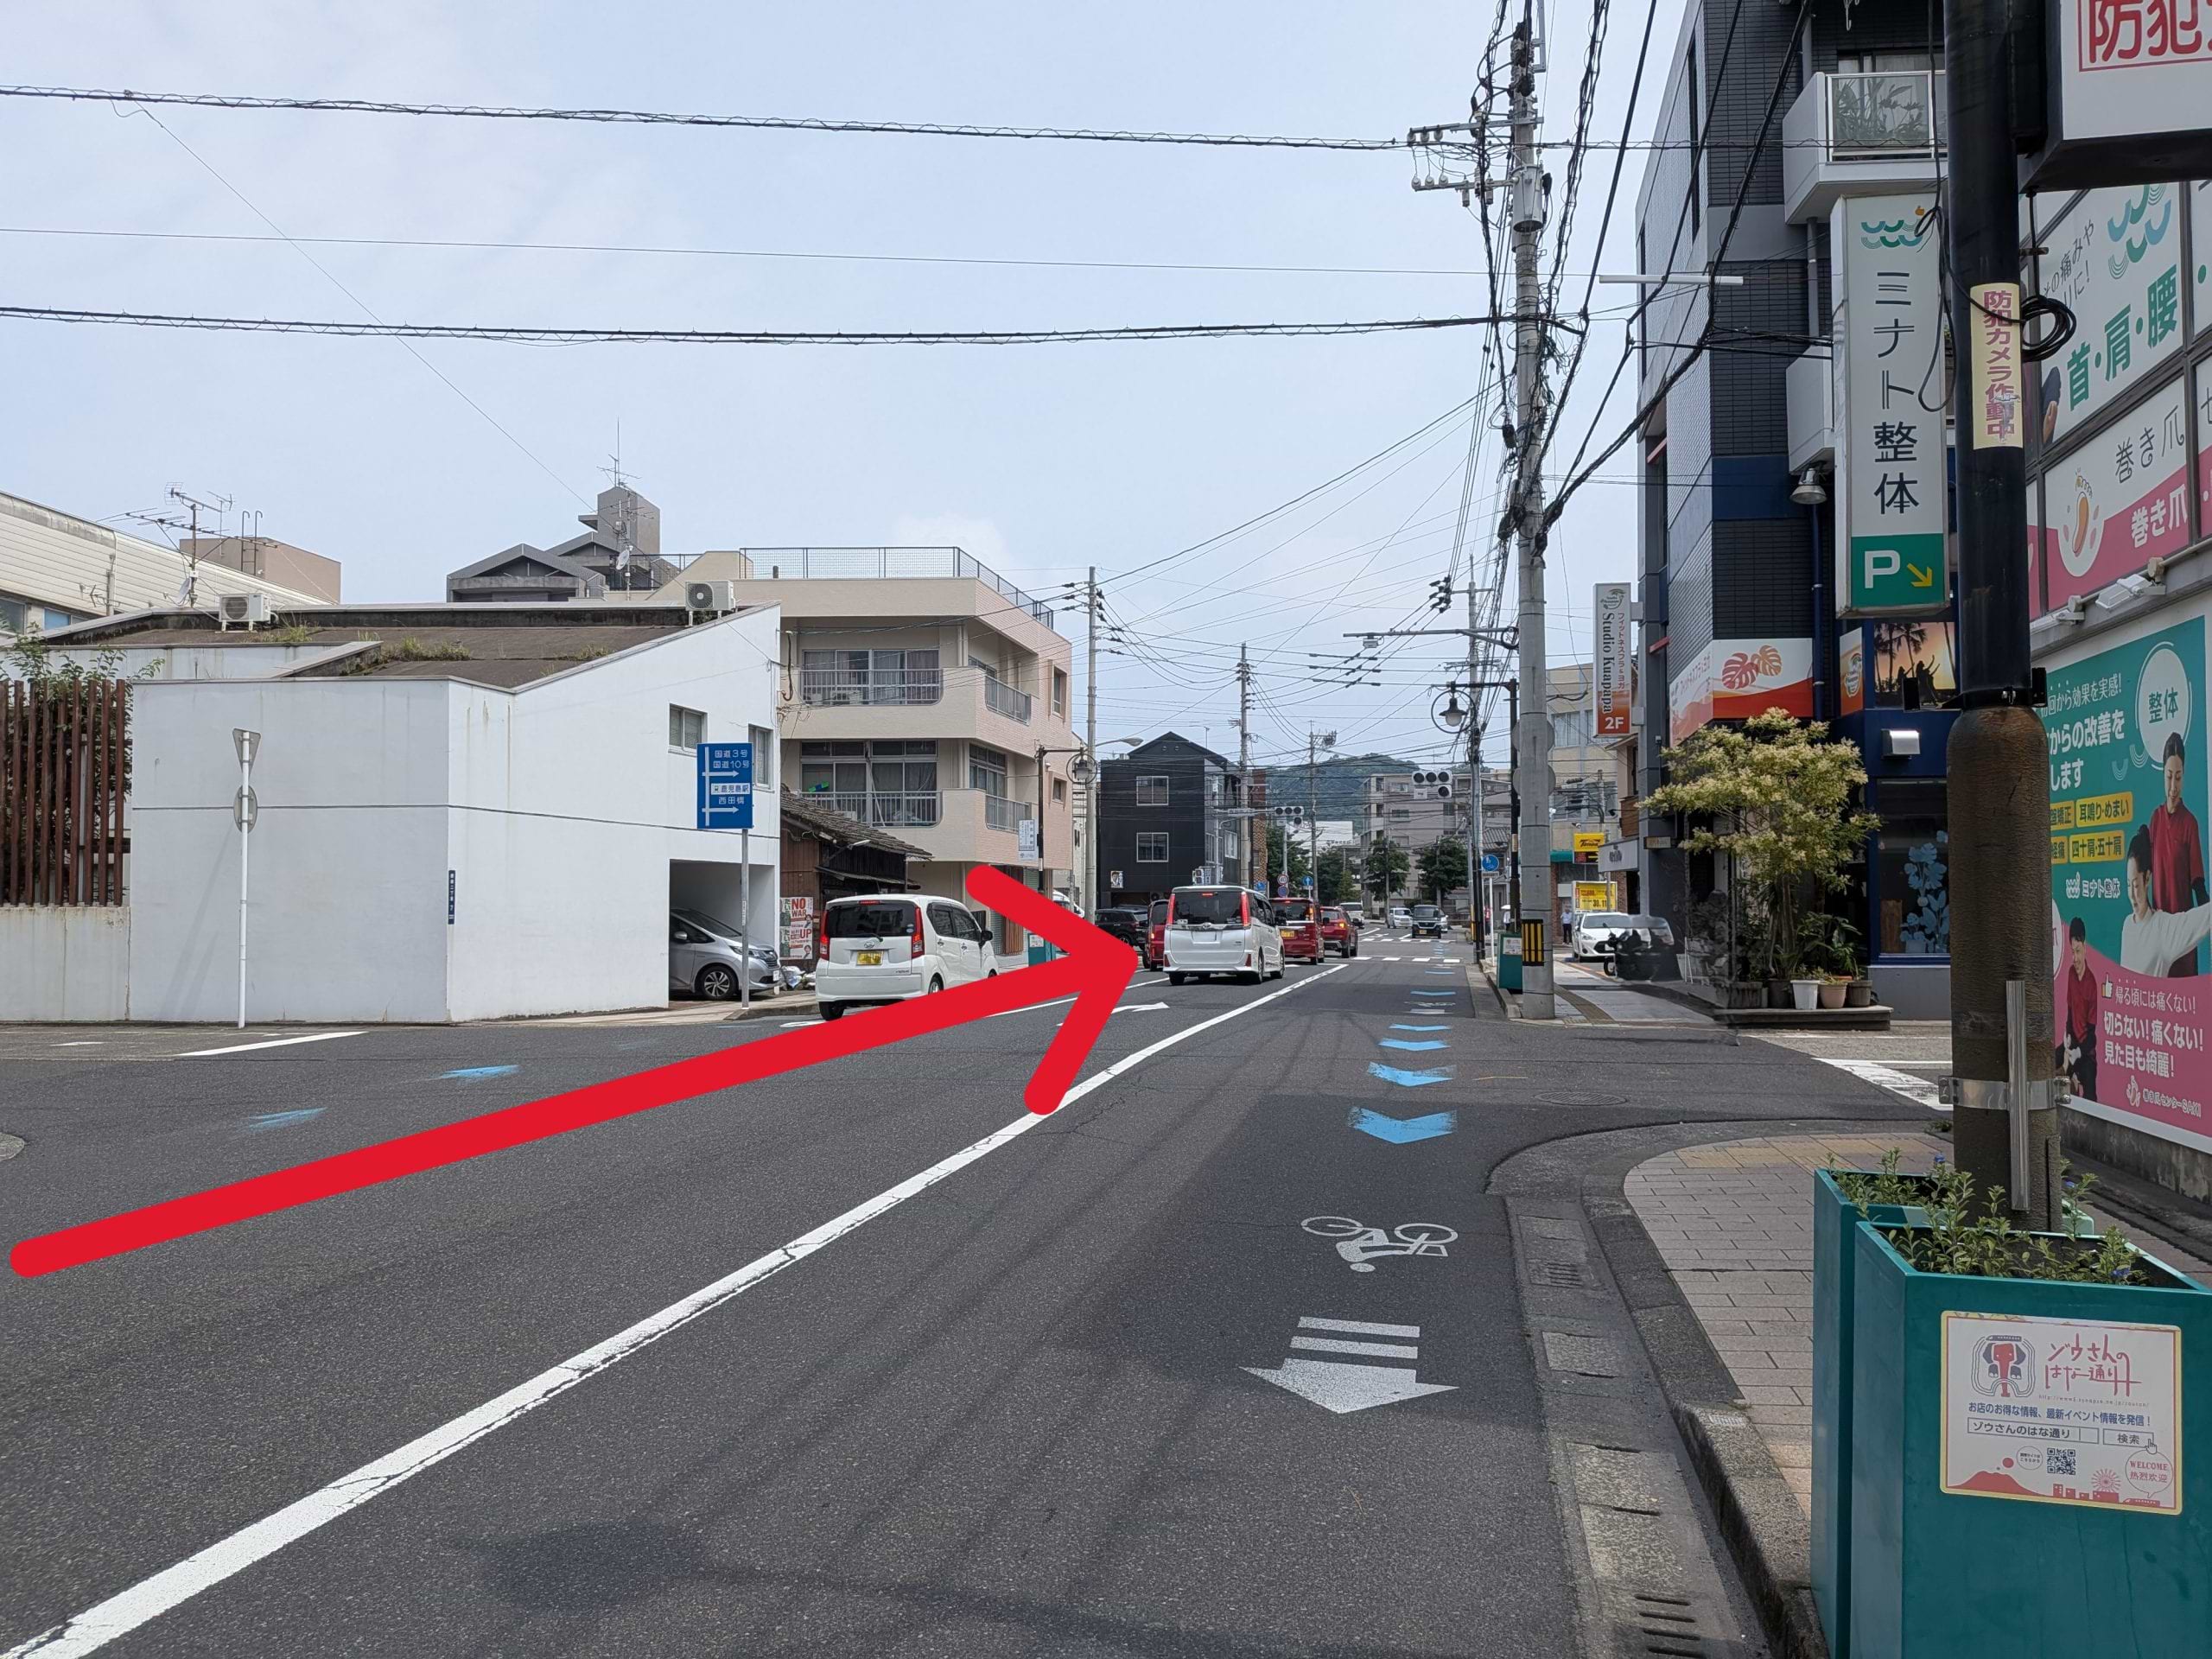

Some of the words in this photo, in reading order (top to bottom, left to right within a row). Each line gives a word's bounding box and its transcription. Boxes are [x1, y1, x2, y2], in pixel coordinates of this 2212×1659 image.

[2089, 0, 2212, 63] 防犯
[1983, 290, 2015, 442] 防犯カメラ作動中
[1873, 272, 1919, 515] ミナト整体
[1865, 550, 1900, 588] P
[1603, 613, 1614, 653] Studio
[1601, 658, 1614, 712] Kuapapa
[2149, 688, 2178, 724] 整体
[1605, 717, 1624, 729] 2F
[713, 760, 749, 769] 国道10号
[715, 749, 747, 759] 国道3号
[2082, 878, 2120, 899] ミナト整体
[791, 898, 806, 910] NO
[791, 909, 807, 918] WAR
[800, 928, 812, 939] UP
[2115, 986, 2196, 1014] 帰る頃には痛くない!
[2104, 1040, 2174, 1078] 見た目も綺麗!
[1973, 1421, 2070, 1440] ゾウさんのはな通り
[2117, 1433, 2140, 1446] 検索
[2129, 1460, 2169, 1471] WELCOME
